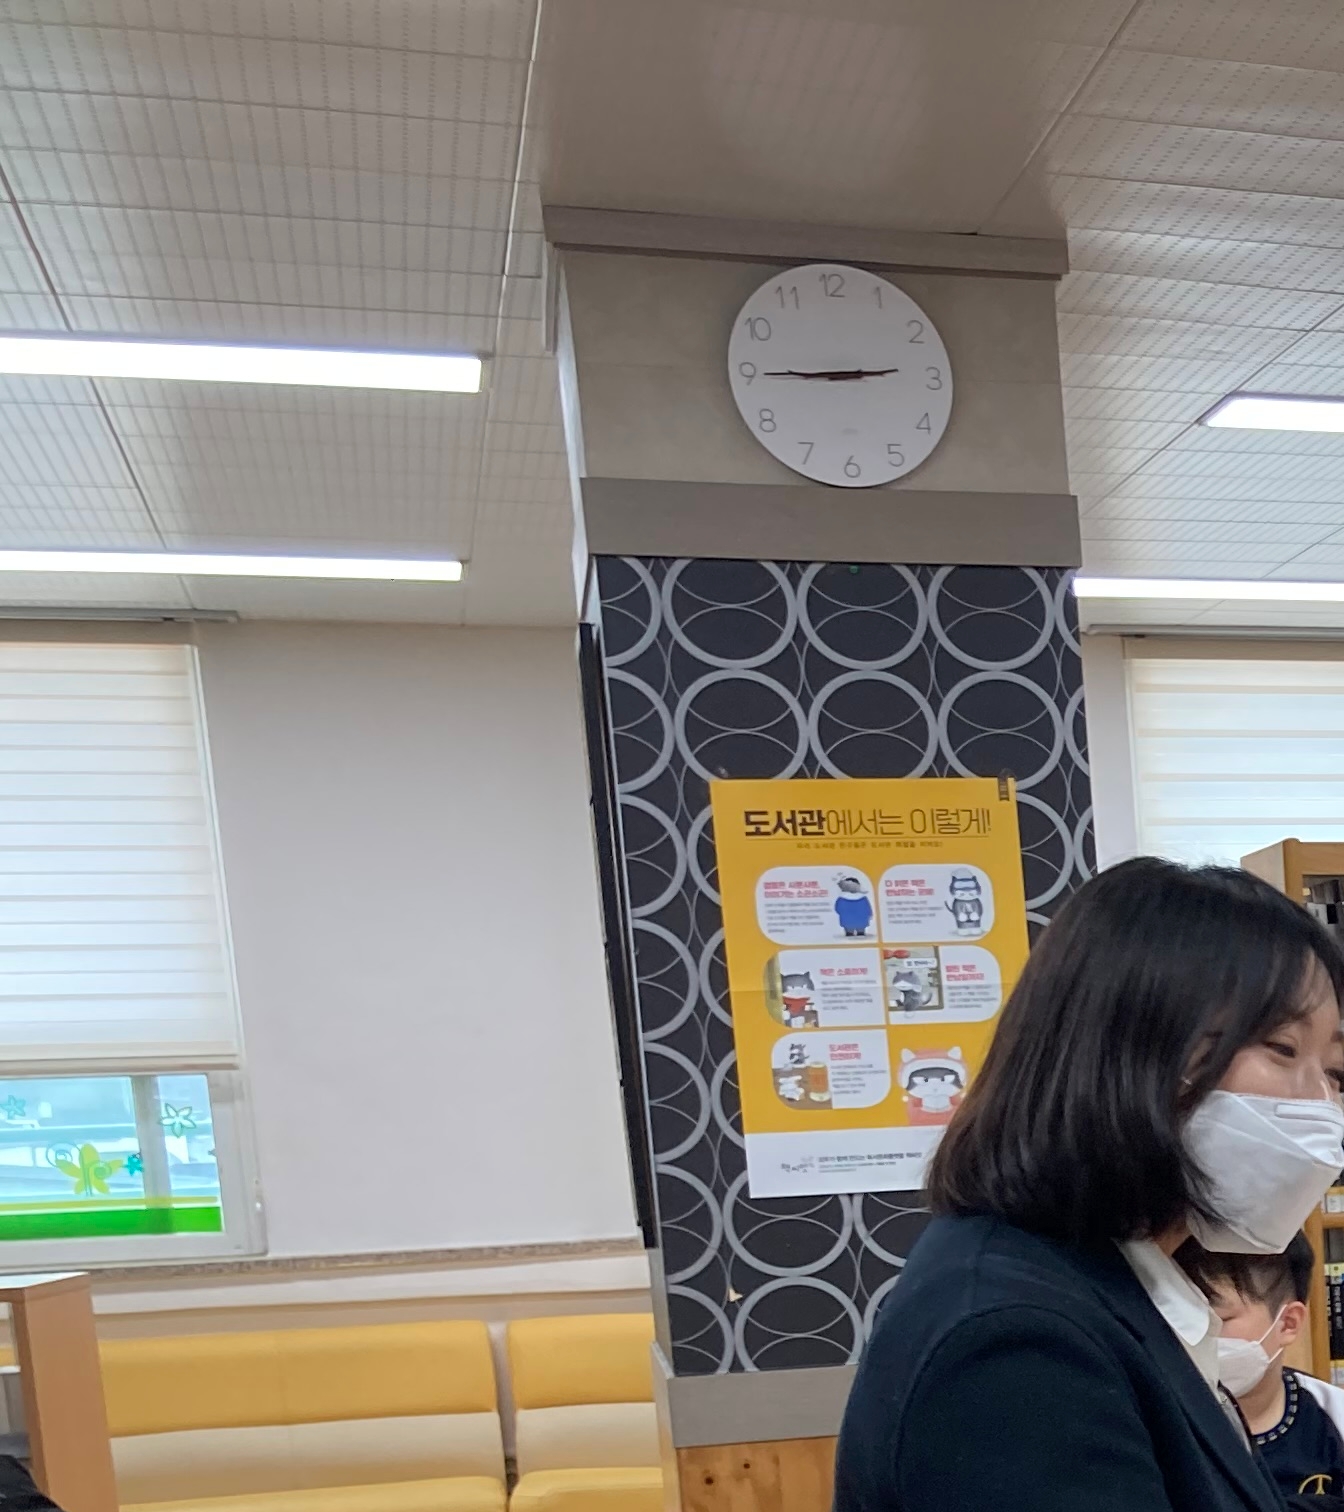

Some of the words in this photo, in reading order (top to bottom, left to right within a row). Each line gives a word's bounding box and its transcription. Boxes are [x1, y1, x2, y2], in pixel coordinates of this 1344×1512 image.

[819, 273, 845, 298] 12
[873, 286, 882, 309] 1
[775, 286, 799, 310] 11
[744, 316, 772, 341] 10
[907, 320, 924, 344] 2
[738, 362, 756, 386] 9
[925, 367, 943, 390] 3
[759, 408, 777, 433] 8
[916, 412, 931, 435] 4
[798, 442, 814, 465] 7
[887, 443, 905, 467] 5
[844, 455, 861, 478] 6
[743, 809, 904, 837] 도서관에서는
[910, 808, 992, 835] 이렇게!
